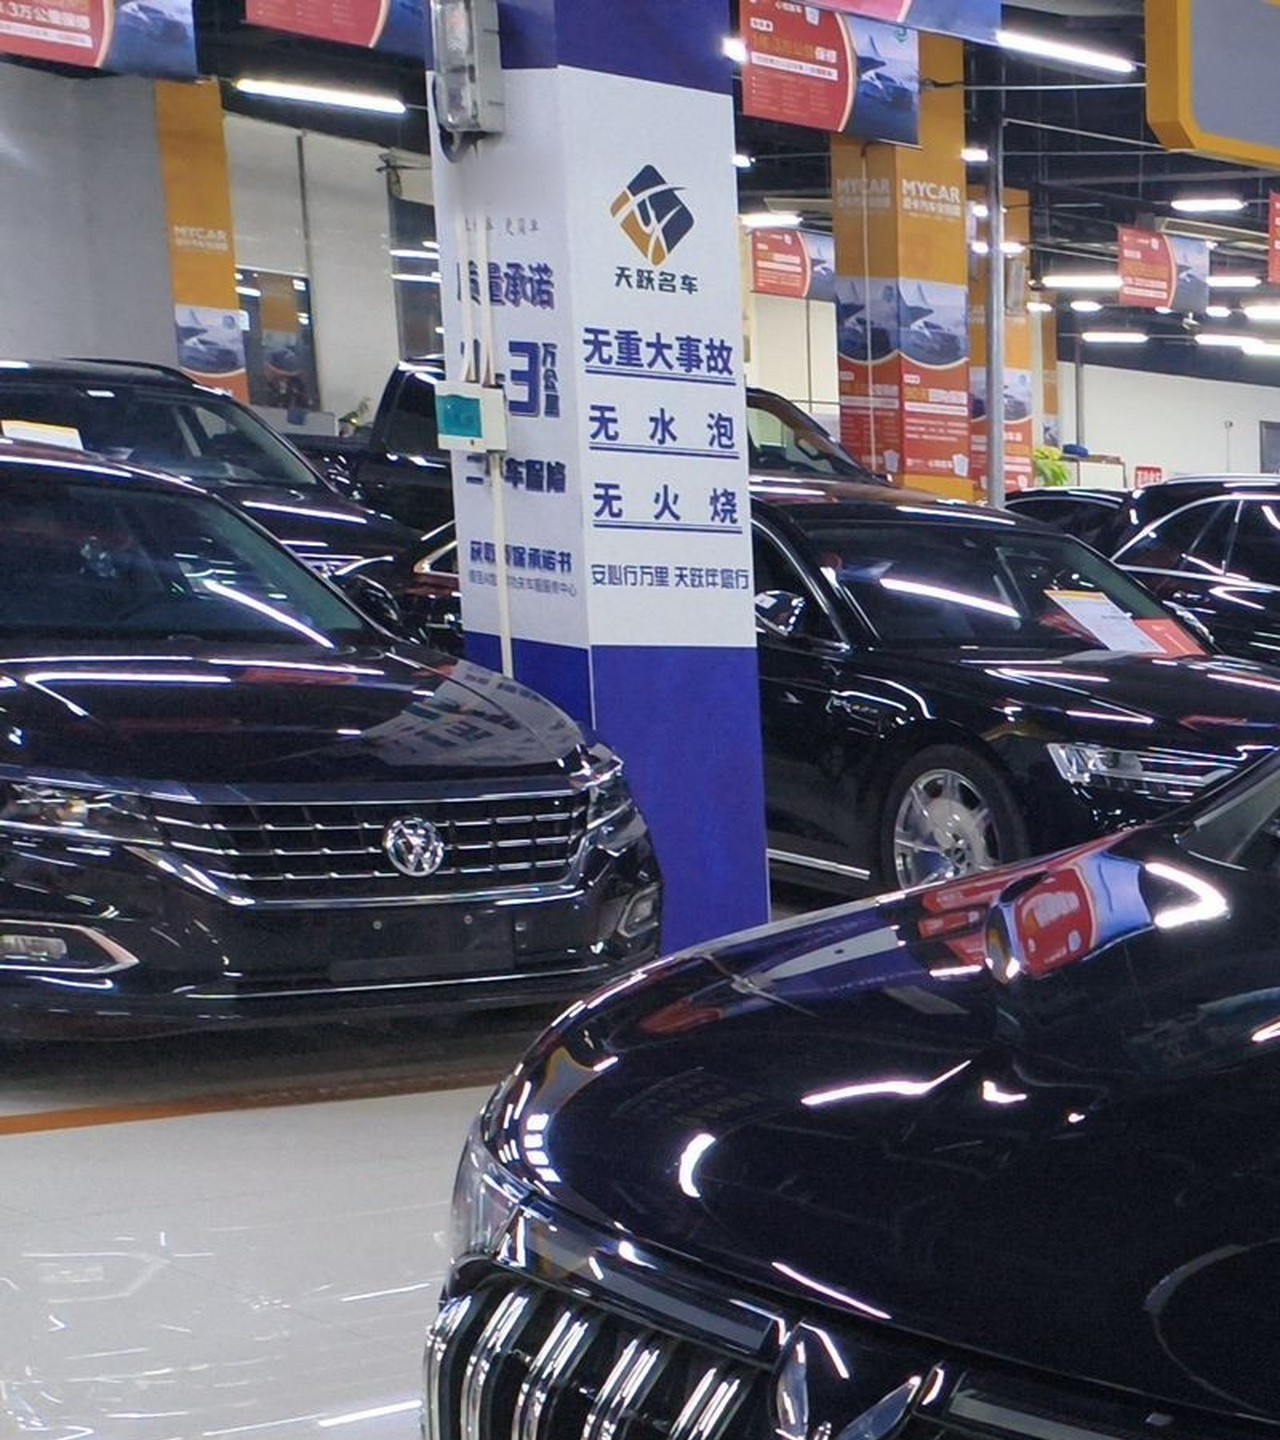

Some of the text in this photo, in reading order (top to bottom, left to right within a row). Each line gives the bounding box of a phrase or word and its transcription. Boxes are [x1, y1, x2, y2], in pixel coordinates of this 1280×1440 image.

[902, 179, 960, 204] MYCAR
[614, 266, 699, 295] 天跃名车
[582, 327, 734, 376] 无重大事故
[591, 564, 669, 586] 安心行万里
